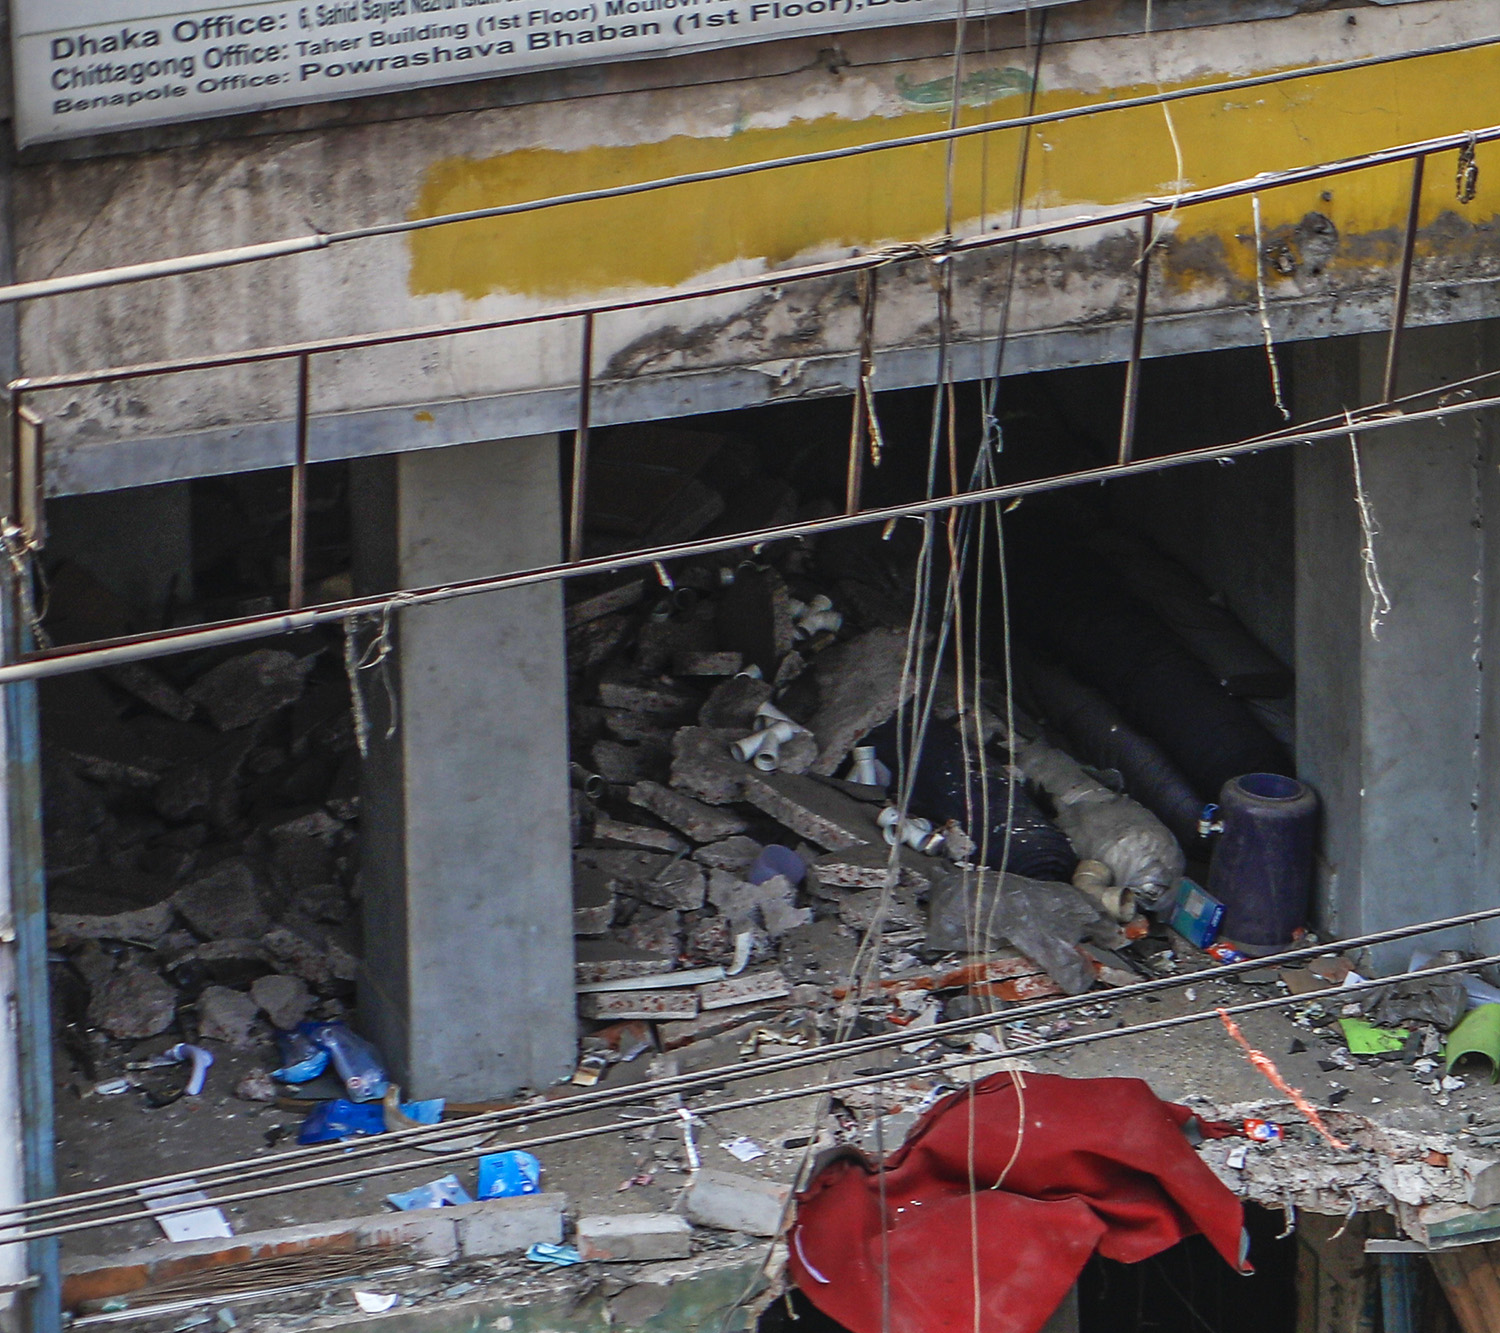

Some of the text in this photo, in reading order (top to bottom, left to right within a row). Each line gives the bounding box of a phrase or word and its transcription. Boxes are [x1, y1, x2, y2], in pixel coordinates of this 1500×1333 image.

[51, 27, 160, 61] Dhaka
[172, 11, 288, 44] Office:
[316, 2, 359, 29] Sahid
[52, 54, 194, 91] Chittagong
[204, 42, 289, 70] Office:
[298, 34, 361, 58] Taher
[370, 20, 468, 48] Building
[476, 15, 521, 38] (1st
[528, 2, 597, 28] Floor)
[52, 83, 188, 116] Benapole
[199, 70, 290, 95] Office:
[299, 37, 515, 82] Powrashava
[527, 21, 660, 52] Bhaban
[673, 10, 739, 36] (1st
